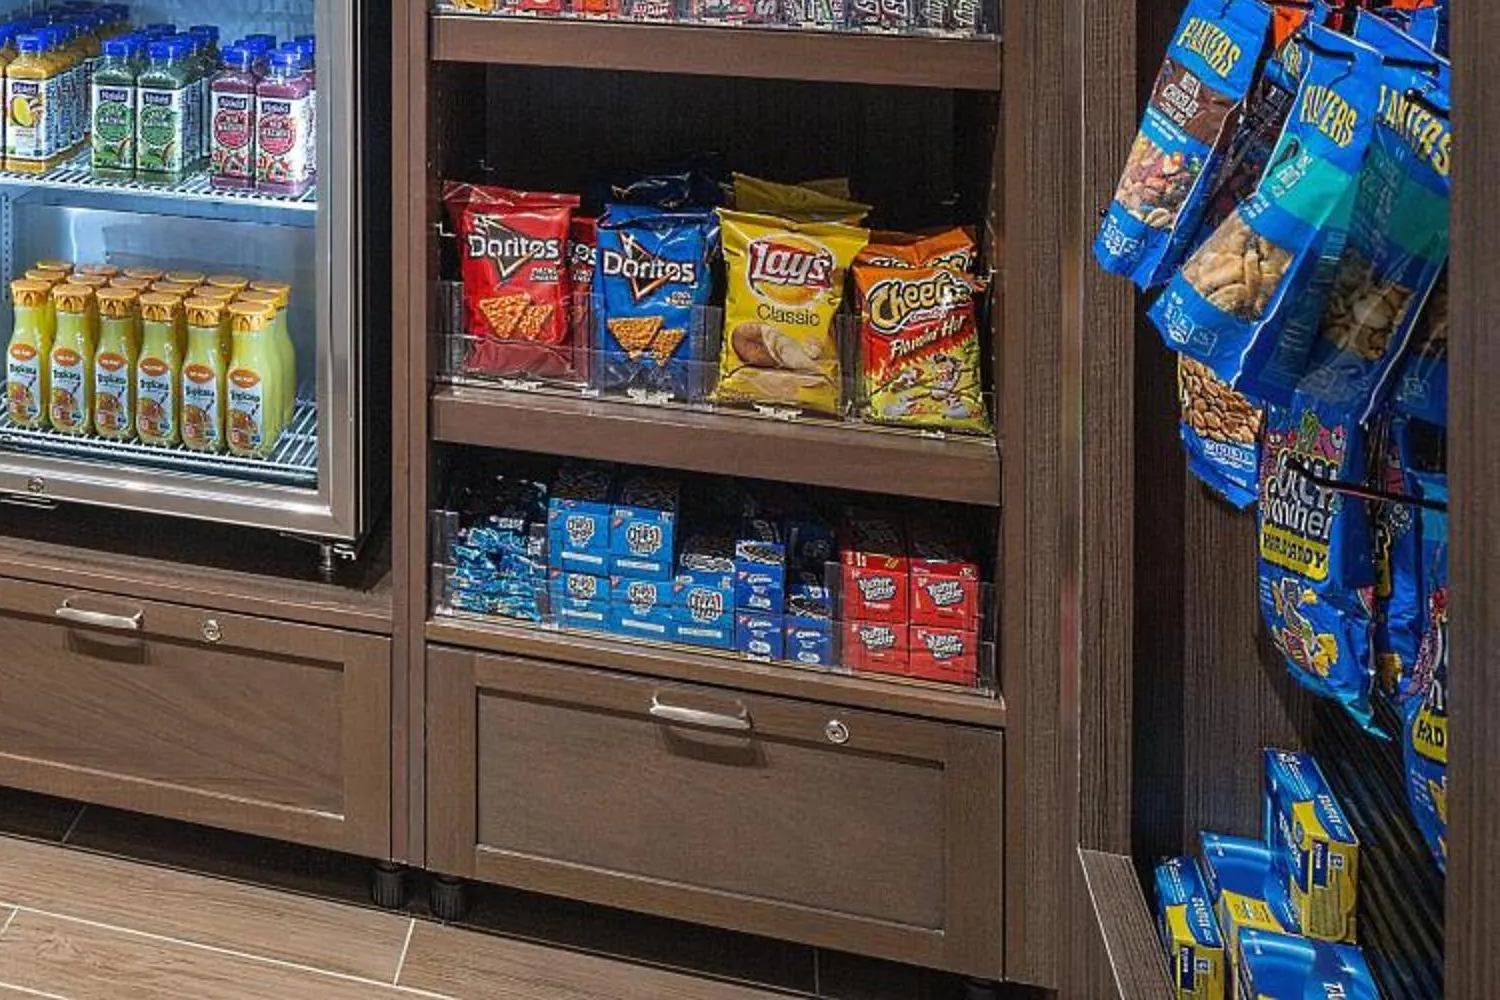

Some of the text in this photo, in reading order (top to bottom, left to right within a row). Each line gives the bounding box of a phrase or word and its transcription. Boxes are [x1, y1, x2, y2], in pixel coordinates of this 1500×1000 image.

[467, 234, 559, 259] Doritos
[603, 251, 695, 282] Doritos
[757, 303, 821, 327] Classic
